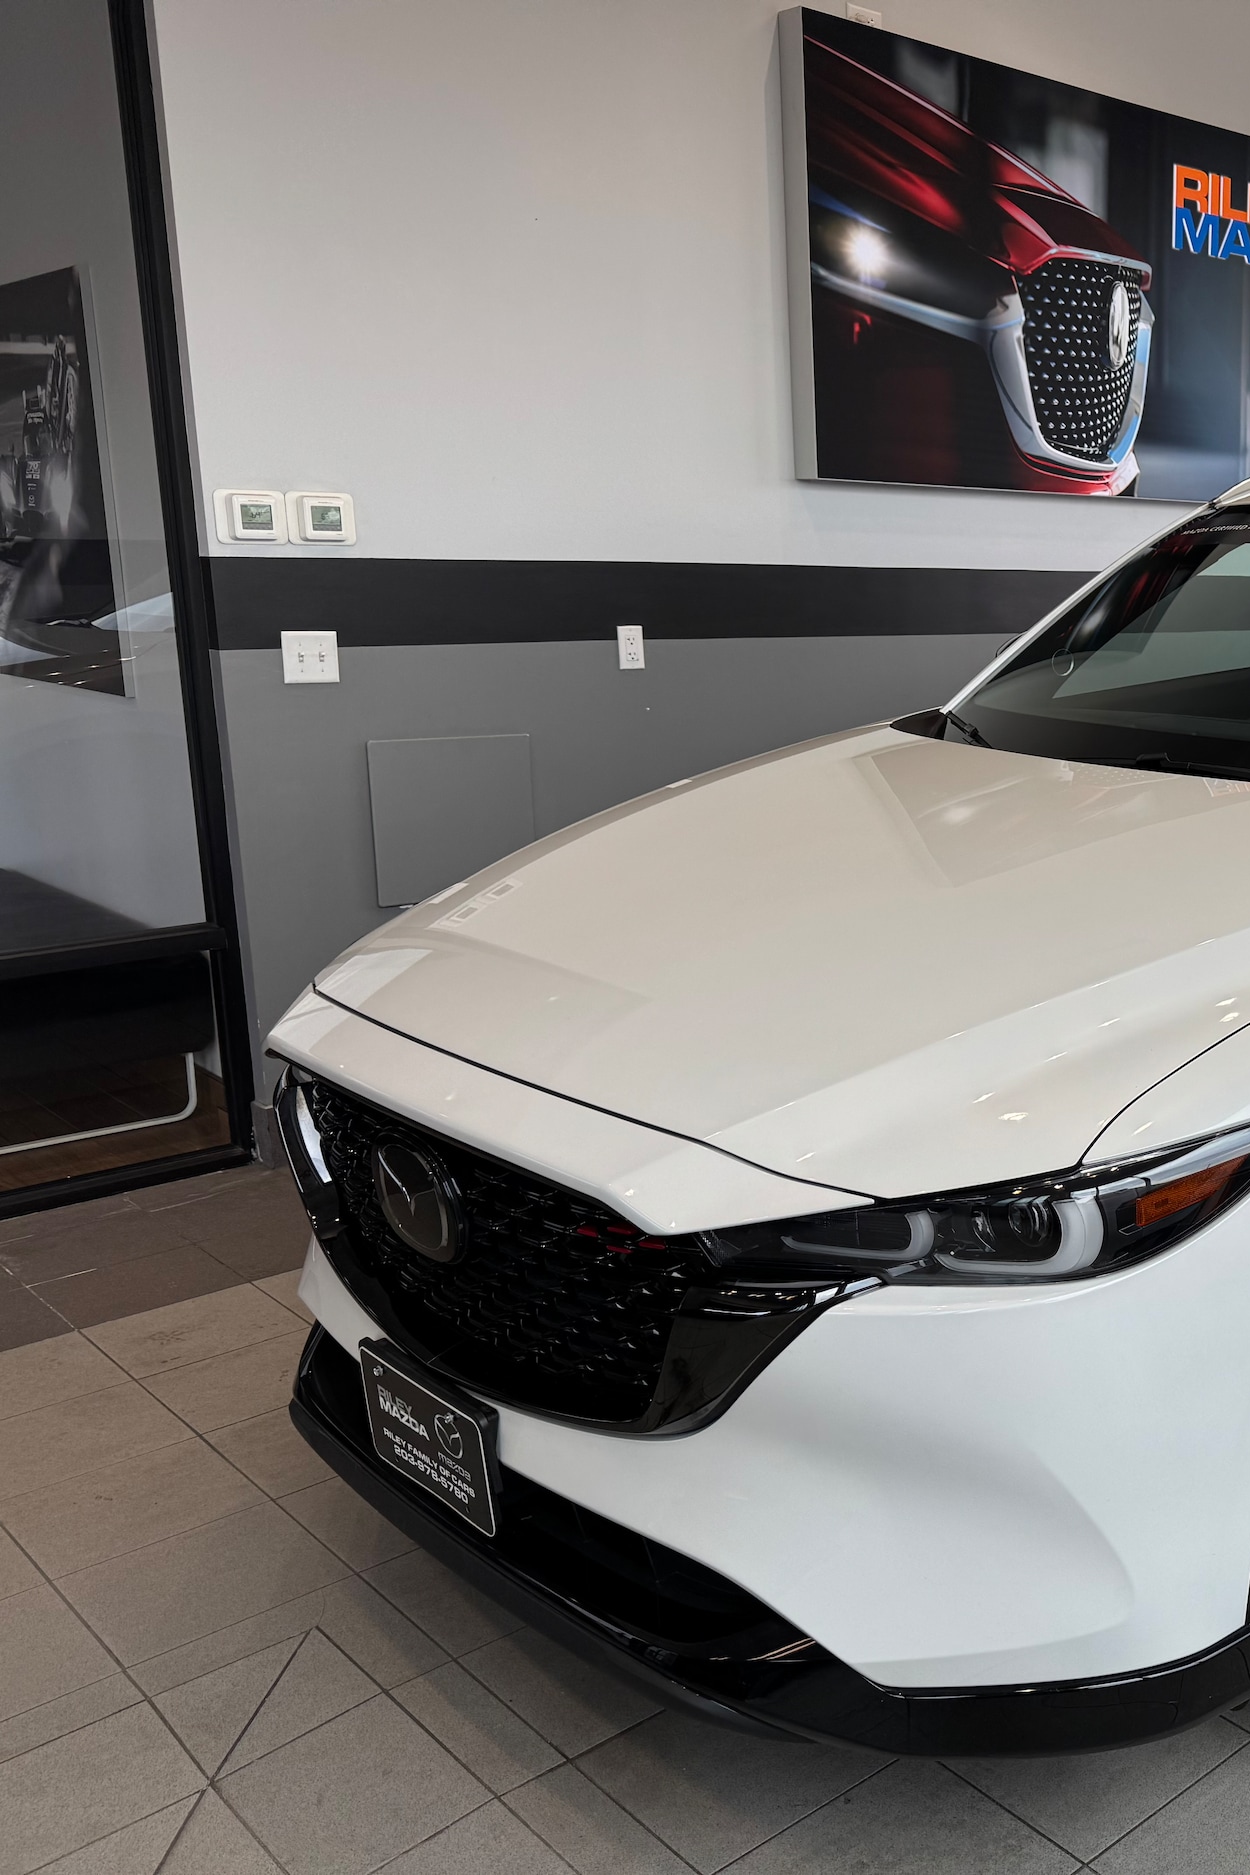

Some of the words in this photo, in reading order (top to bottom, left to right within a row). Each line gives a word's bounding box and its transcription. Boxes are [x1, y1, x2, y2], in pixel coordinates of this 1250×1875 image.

[1209, 524, 1249, 532] CERTIFIED
[376, 1384, 413, 1417] RILEY
[379, 1397, 431, 1442] MAZDA
[382, 1427, 407, 1448] RILEY
[406, 1443, 439, 1470] FAMILY
[438, 1465, 451, 1478] OF
[450, 1473, 476, 1498] CARS
